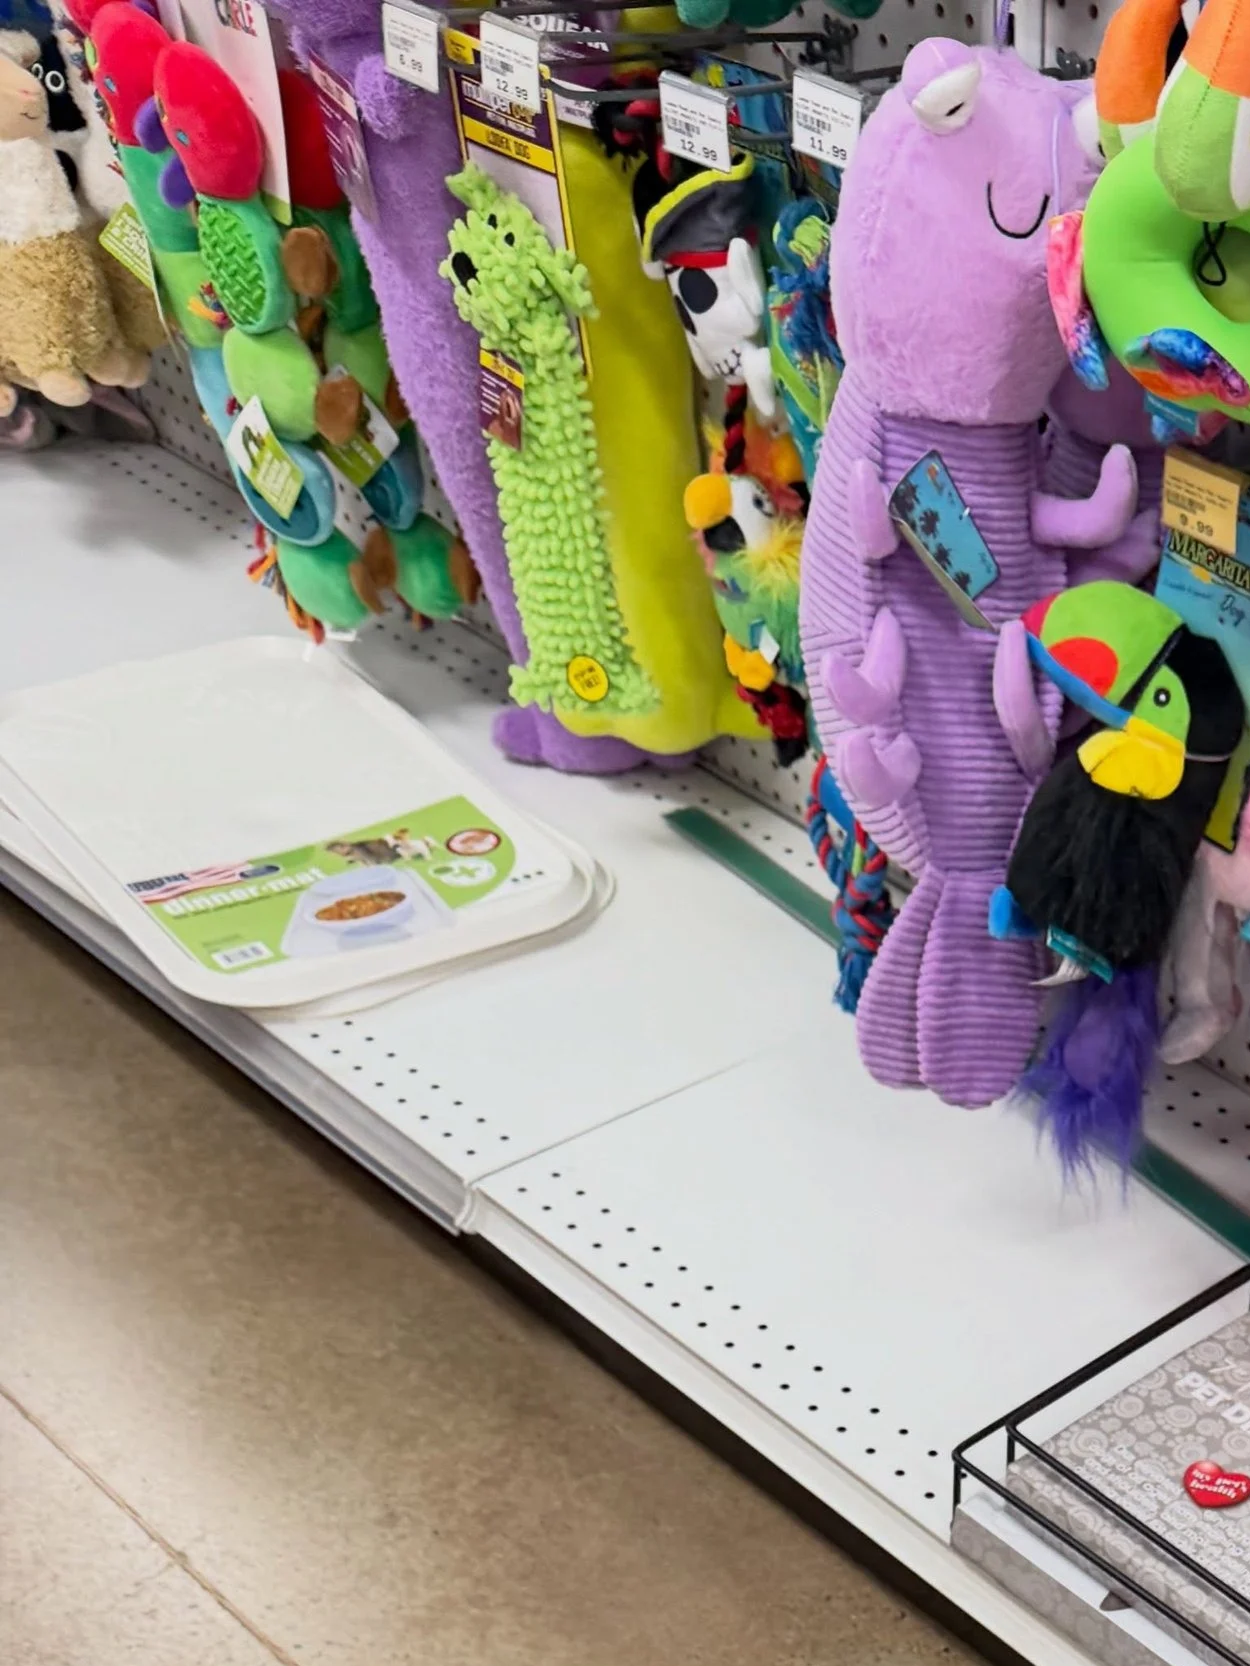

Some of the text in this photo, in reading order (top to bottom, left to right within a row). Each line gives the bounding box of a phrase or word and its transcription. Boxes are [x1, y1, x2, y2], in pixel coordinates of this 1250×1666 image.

[495, 77, 528, 101] 12.99
[680, 138, 718, 162] 12.99
[810, 136, 847, 161] 11.99
[1220, 593, 1246, 627] Dog
[1176, 1371, 1231, 1408] PET
[1190, 1480, 1237, 1500] health
[1191, 1469, 1247, 1493] my pet's
